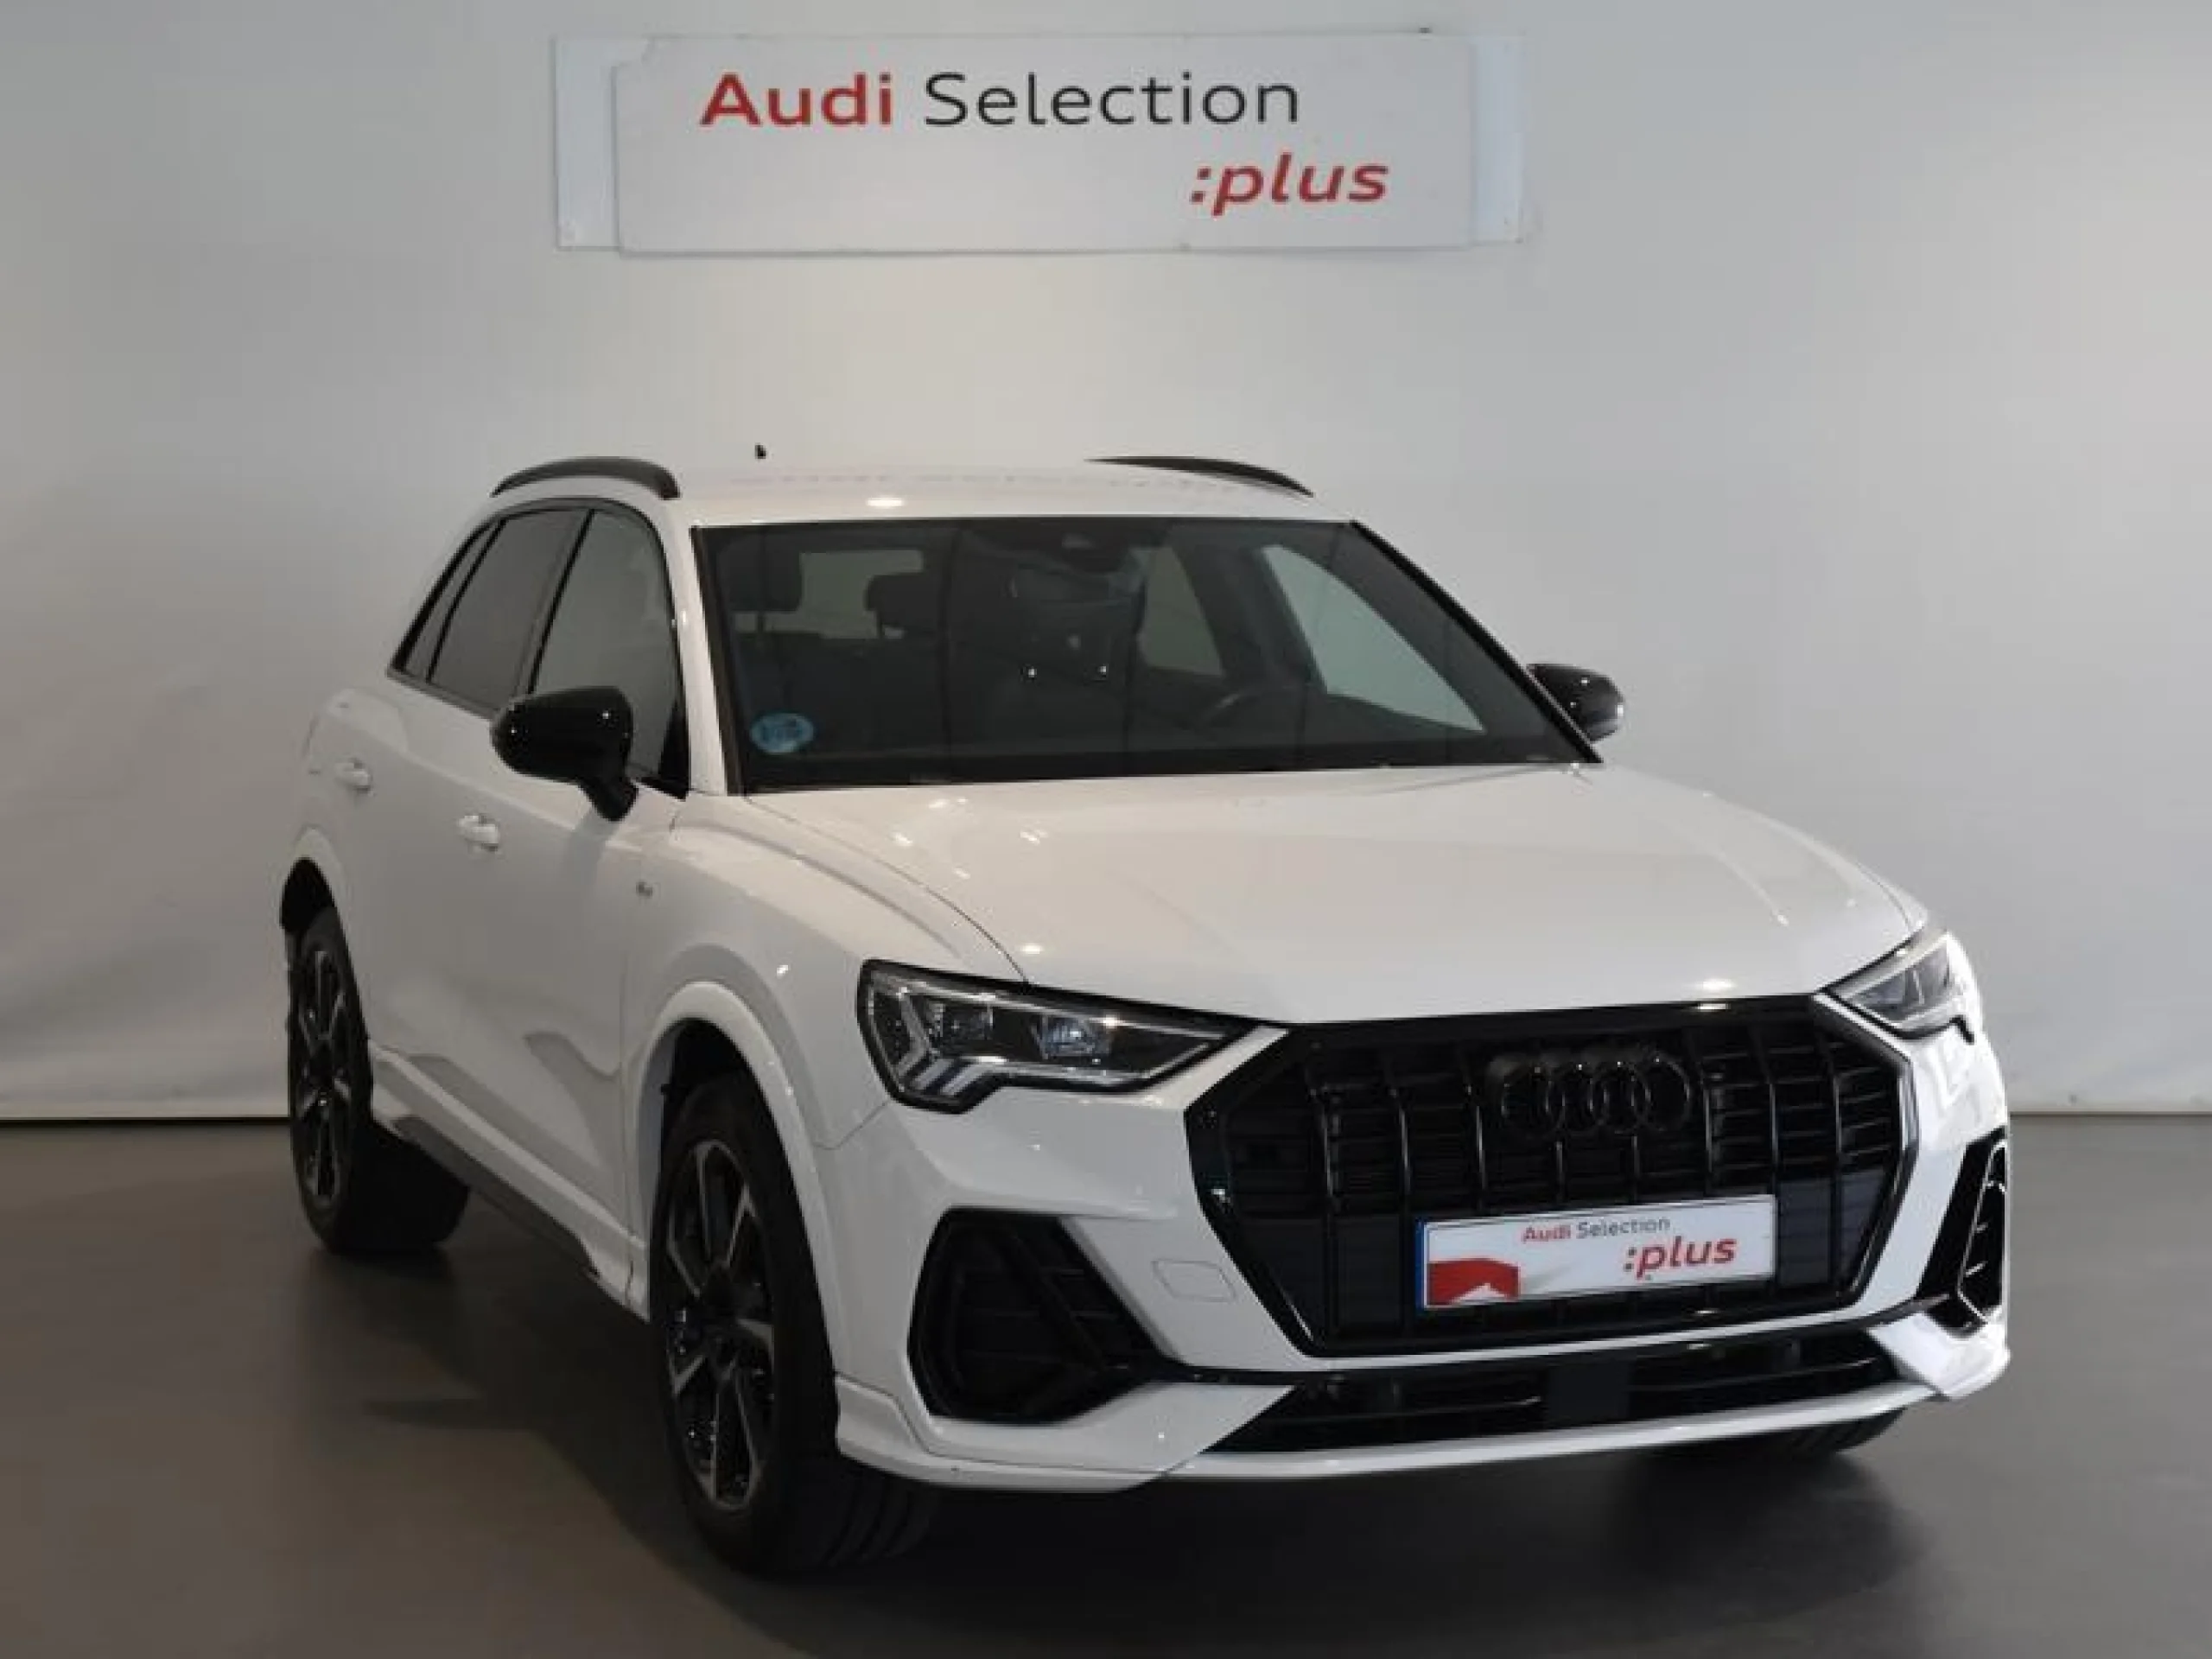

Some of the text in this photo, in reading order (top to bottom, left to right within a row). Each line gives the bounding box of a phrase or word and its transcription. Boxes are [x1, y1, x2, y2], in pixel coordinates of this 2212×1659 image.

[700, 71, 1299, 126] Audi Selection
[1190, 152, 1389, 216] :plus
[1522, 1216, 1671, 1244] Audi Selection
[1623, 1235, 1738, 1281] :plus
